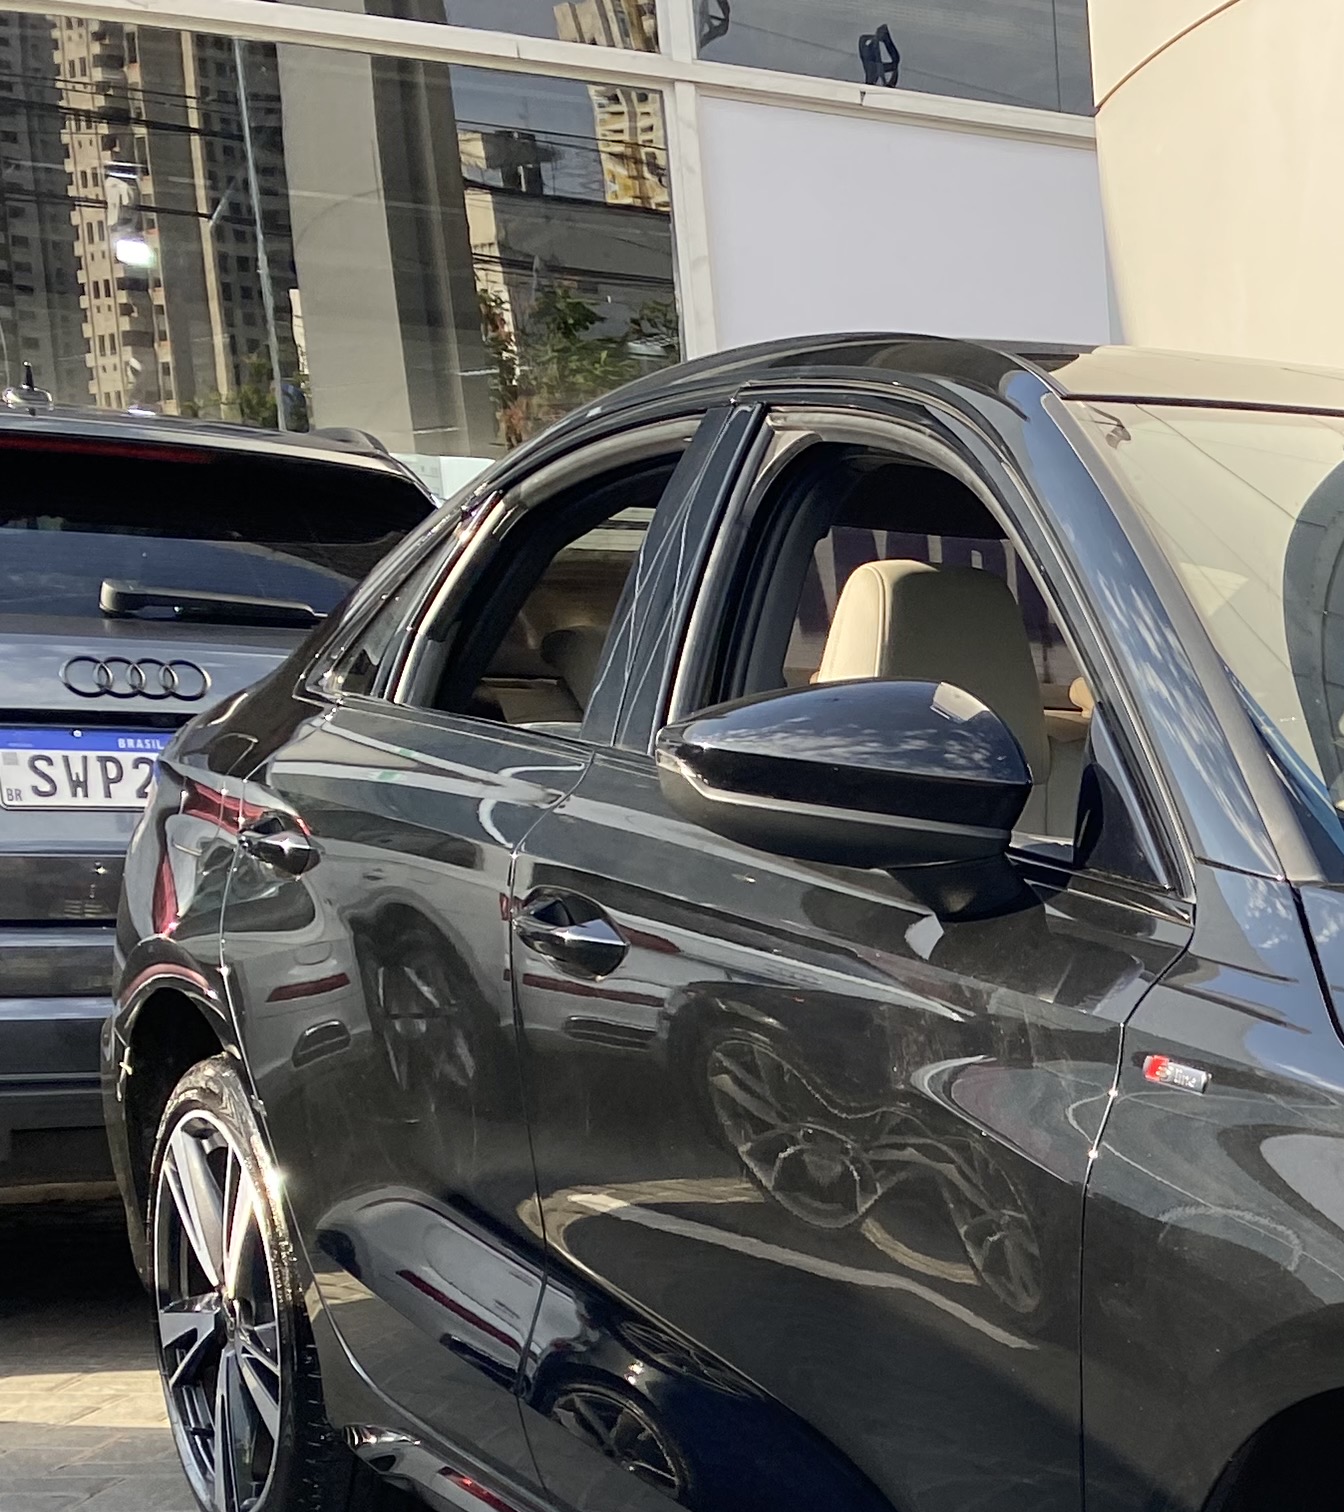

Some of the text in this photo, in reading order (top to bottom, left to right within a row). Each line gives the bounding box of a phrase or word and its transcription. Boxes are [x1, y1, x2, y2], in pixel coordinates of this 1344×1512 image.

[118, 737, 164, 750] BRASIL
[28, 754, 156, 799] SWP2
[6, 787, 23, 802] BR
